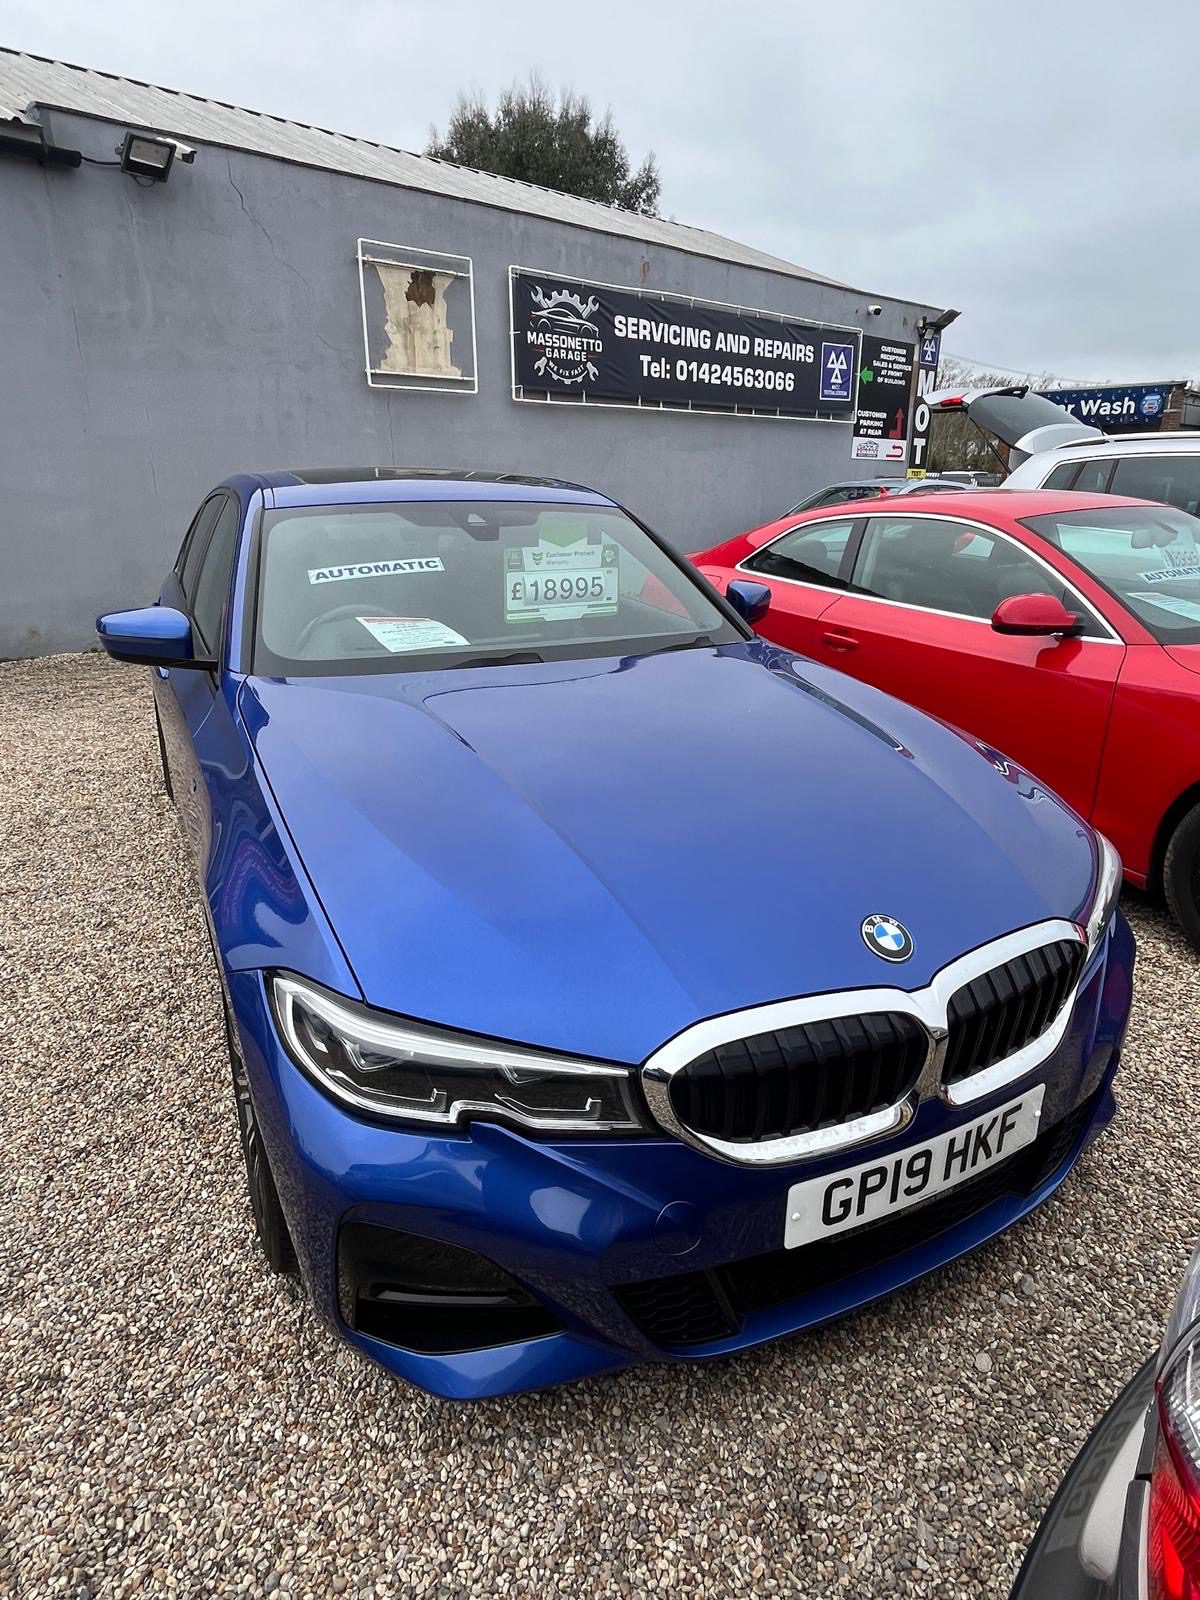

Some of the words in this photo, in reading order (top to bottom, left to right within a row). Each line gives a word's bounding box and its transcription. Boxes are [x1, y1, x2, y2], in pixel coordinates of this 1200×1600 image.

[527, 330, 602, 352] MASSONETTO
[613, 314, 711, 350] SERVICING
[715, 335, 750, 356] AND
[753, 338, 815, 363] REPAIRS
[545, 347, 587, 361] GARAGE
[881, 346, 907, 354] CUSTOMER
[881, 354, 906, 362] RECEPTION
[559, 369, 570, 377] FIX
[570, 364, 584, 376] FAST
[639, 354, 671, 380] Tel:
[675, 359, 795, 392] 01424563066
[873, 360, 888, 368] SALES
[893, 363, 912, 371] SERVICE
[857, 410, 887, 419] CUSTOMER
[1080, 396, 1136, 416] Wash
[868, 428, 882, 436] REAR
[315, 559, 440, 581] AUTOMATIC
[511, 576, 604, 601] £18995
[864, 916, 899, 933] BMW
[821, 1148, 933, 1227] GP19
[943, 1102, 1024, 1182] HKF
